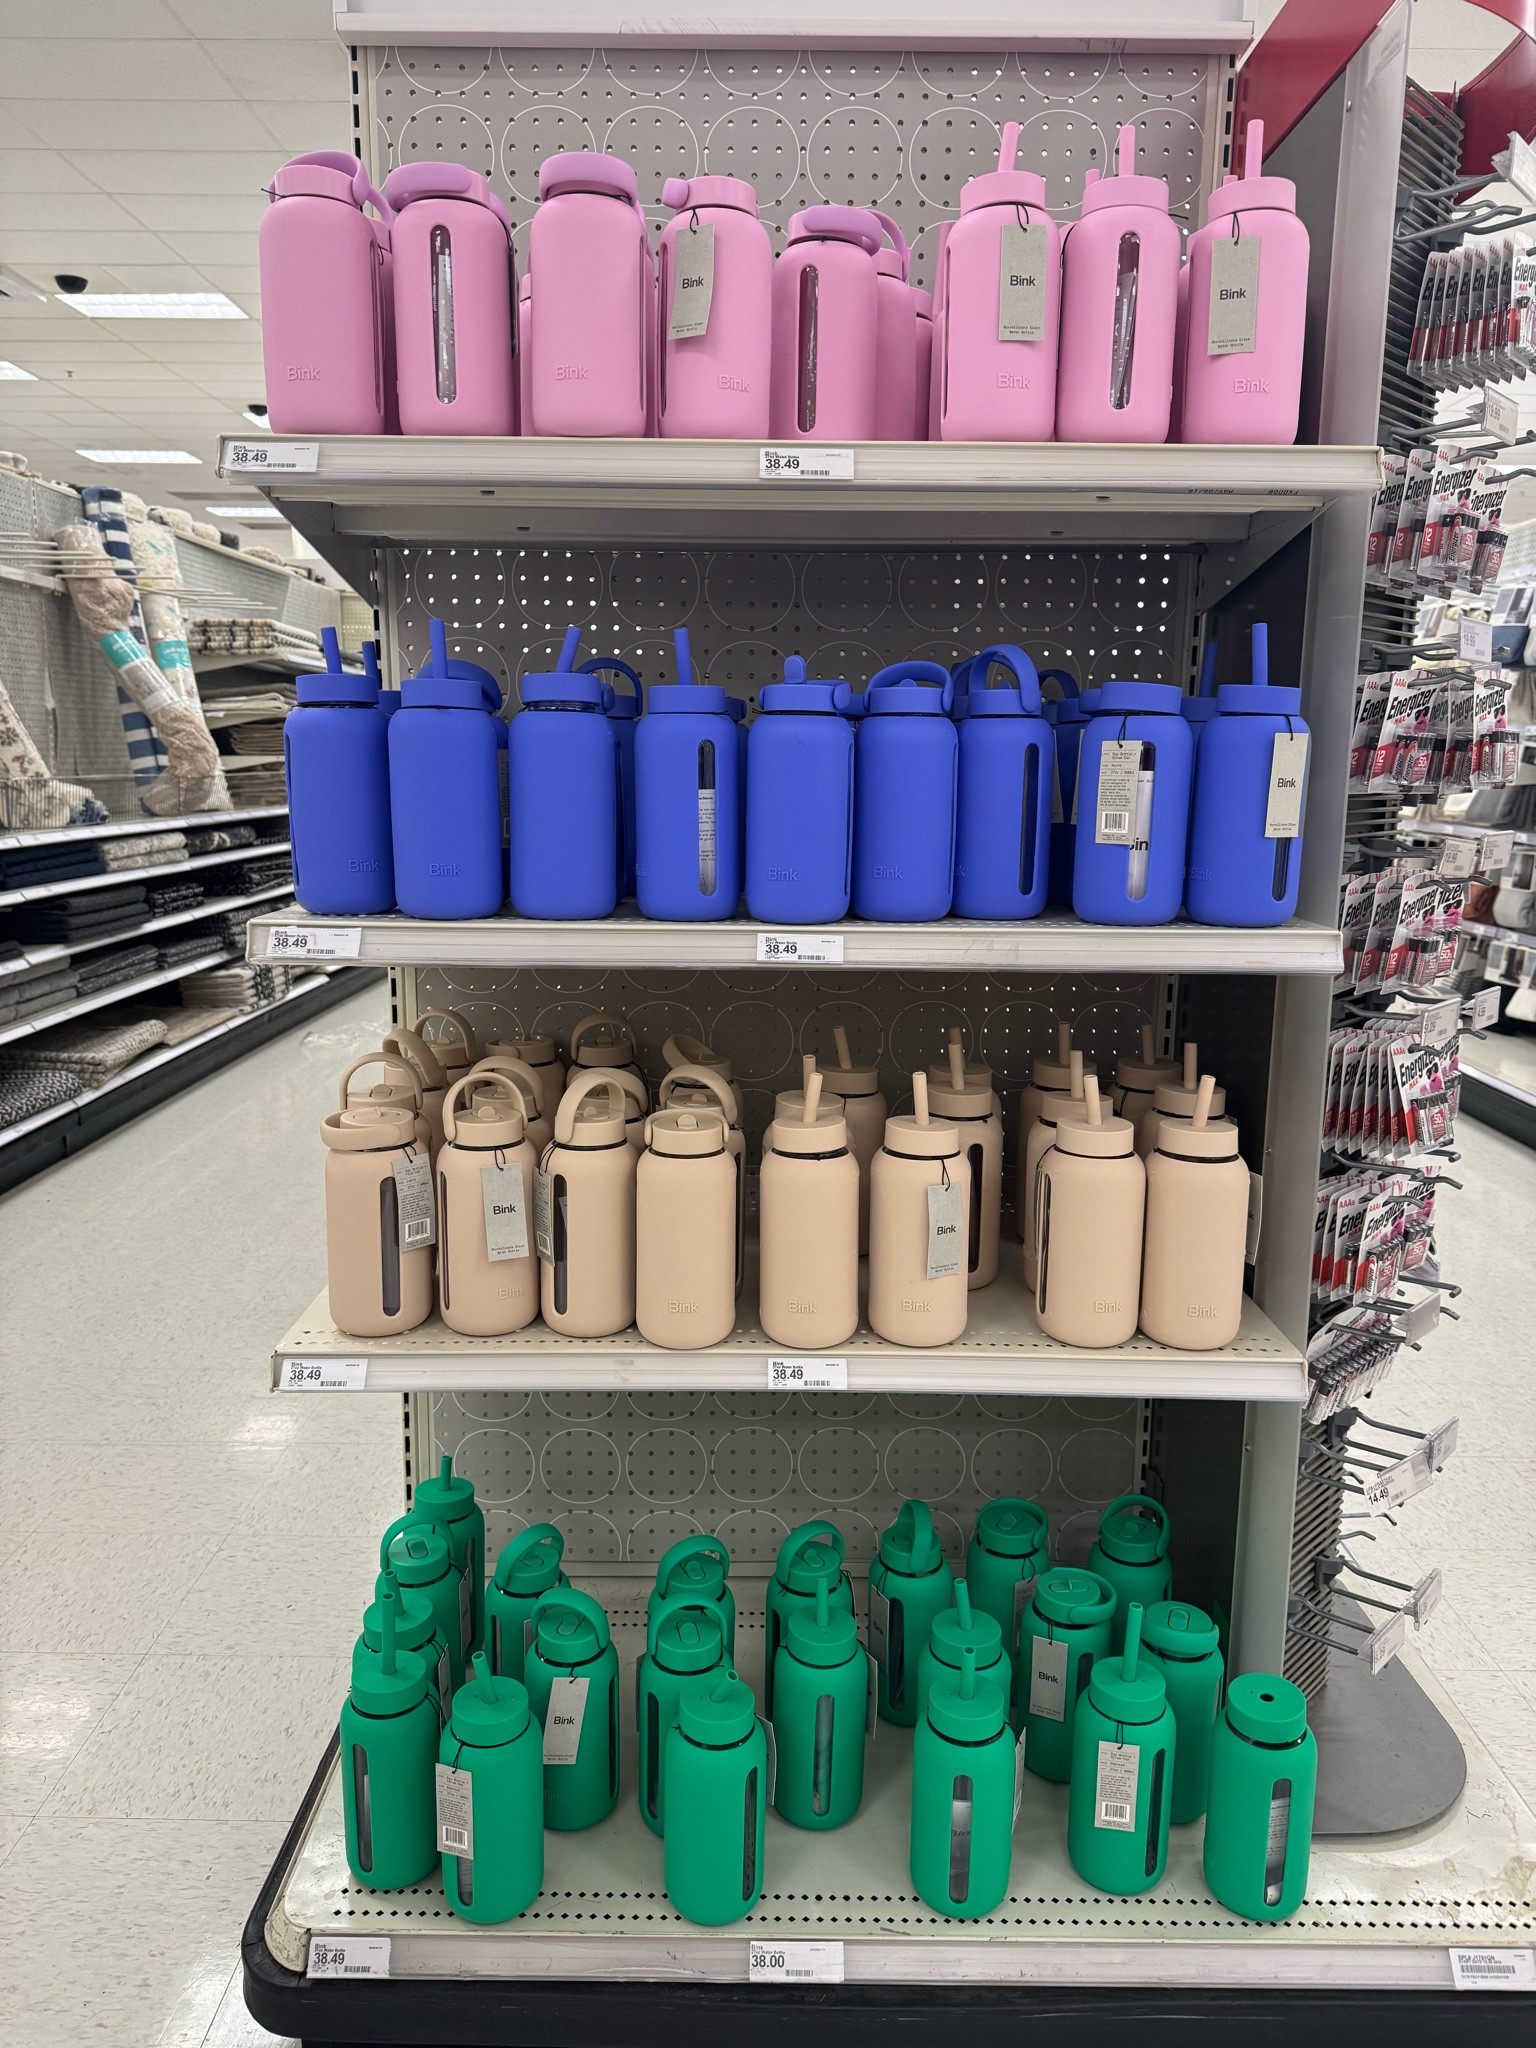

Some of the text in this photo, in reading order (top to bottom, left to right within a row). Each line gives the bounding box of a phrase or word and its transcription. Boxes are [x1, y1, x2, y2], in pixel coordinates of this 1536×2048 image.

[682, 276, 704, 289] Bink
[1010, 275, 1036, 286] Bink
[1220, 288, 1246, 300] Bink
[287, 366, 320, 381] Bink
[555, 365, 588, 380] Bink
[718, 375, 750, 392] Bink
[998, 373, 1030, 389] Bink
[1234, 378, 1269, 394] Bink
[232, 452, 268, 462] 38.49
[766, 458, 800, 468] 38.49
[1433, 468, 1477, 497] Energizer
[1426, 528, 1433, 542] 12
[1387, 688, 1437, 720] Energizer
[1475, 688, 1506, 717] Energizer
[1376, 750, 1386, 763] 12
[1277, 778, 1296, 788] Bink
[348, 860, 379, 872] Bink
[429, 863, 462, 876] Bink
[874, 866, 903, 879] Bink
[768, 867, 798, 881] Bink
[274, 938, 308, 948] 38.49
[766, 944, 798, 954] 38.49
[1390, 953, 1398, 964] 12
[492, 1204, 516, 1215] Bink
[936, 1224, 956, 1236] Bink
[498, 1286, 526, 1300] Bink
[668, 1300, 698, 1314] Bink
[788, 1300, 817, 1314] Bink
[902, 1298, 932, 1312] Bink
[1095, 1300, 1122, 1313] Bink
[1188, 1304, 1218, 1318] Bink
[290, 1370, 321, 1380] 38.49
[773, 1369, 804, 1379] 38.49
[1369, 1486, 1389, 1505] 14.49
[1038, 1672, 1058, 1684] Bink
[554, 1716, 574, 1724] Bink
[314, 1952, 344, 1964] 38.49
[752, 1955, 784, 1968] 38.00
